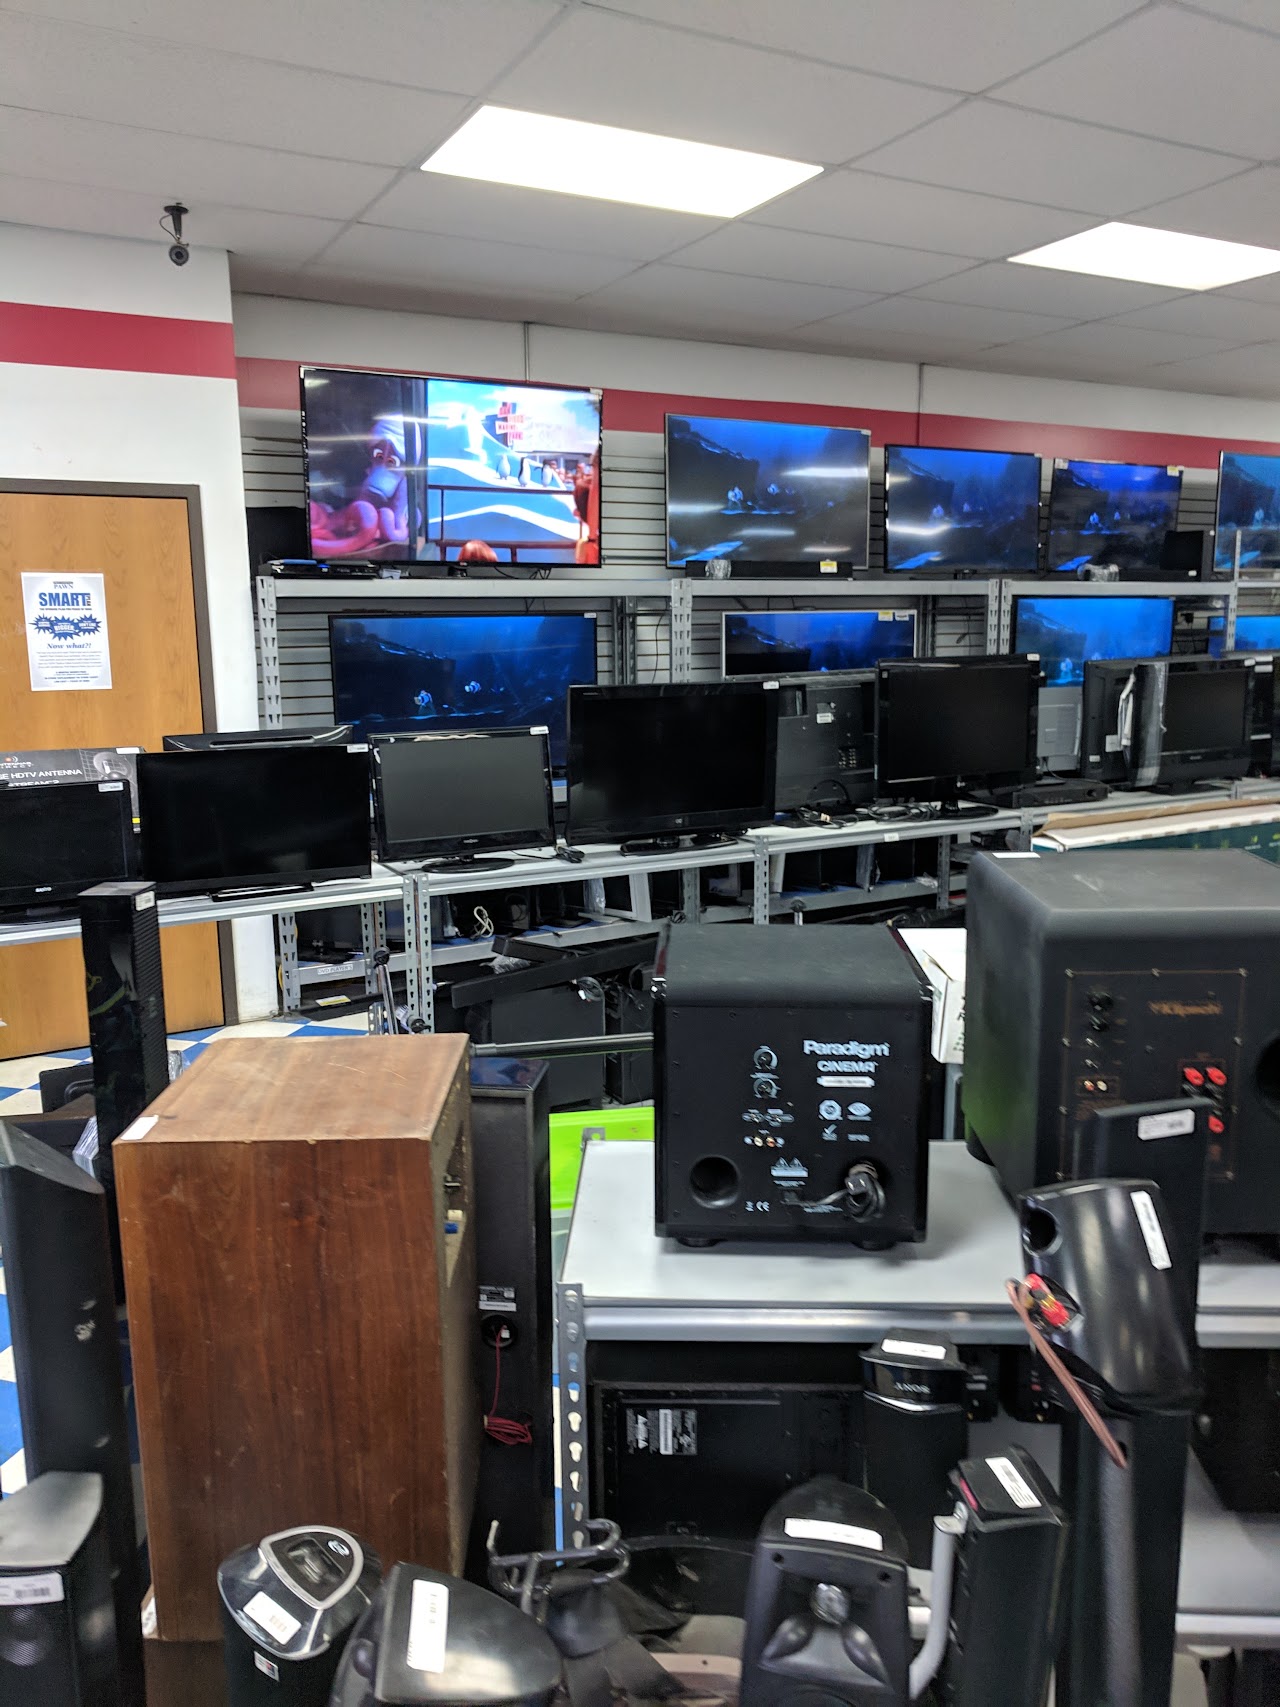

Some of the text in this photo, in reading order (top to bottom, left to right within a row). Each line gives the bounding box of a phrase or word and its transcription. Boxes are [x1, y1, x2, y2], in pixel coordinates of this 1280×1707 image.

[39, 593, 90, 606] SMART
[11, 771, 36, 779] HDTV
[39, 769, 82, 777] ANTENNA
[803, 1040, 890, 1059] Paradigm
[817, 1060, 876, 1073] CINEMA
